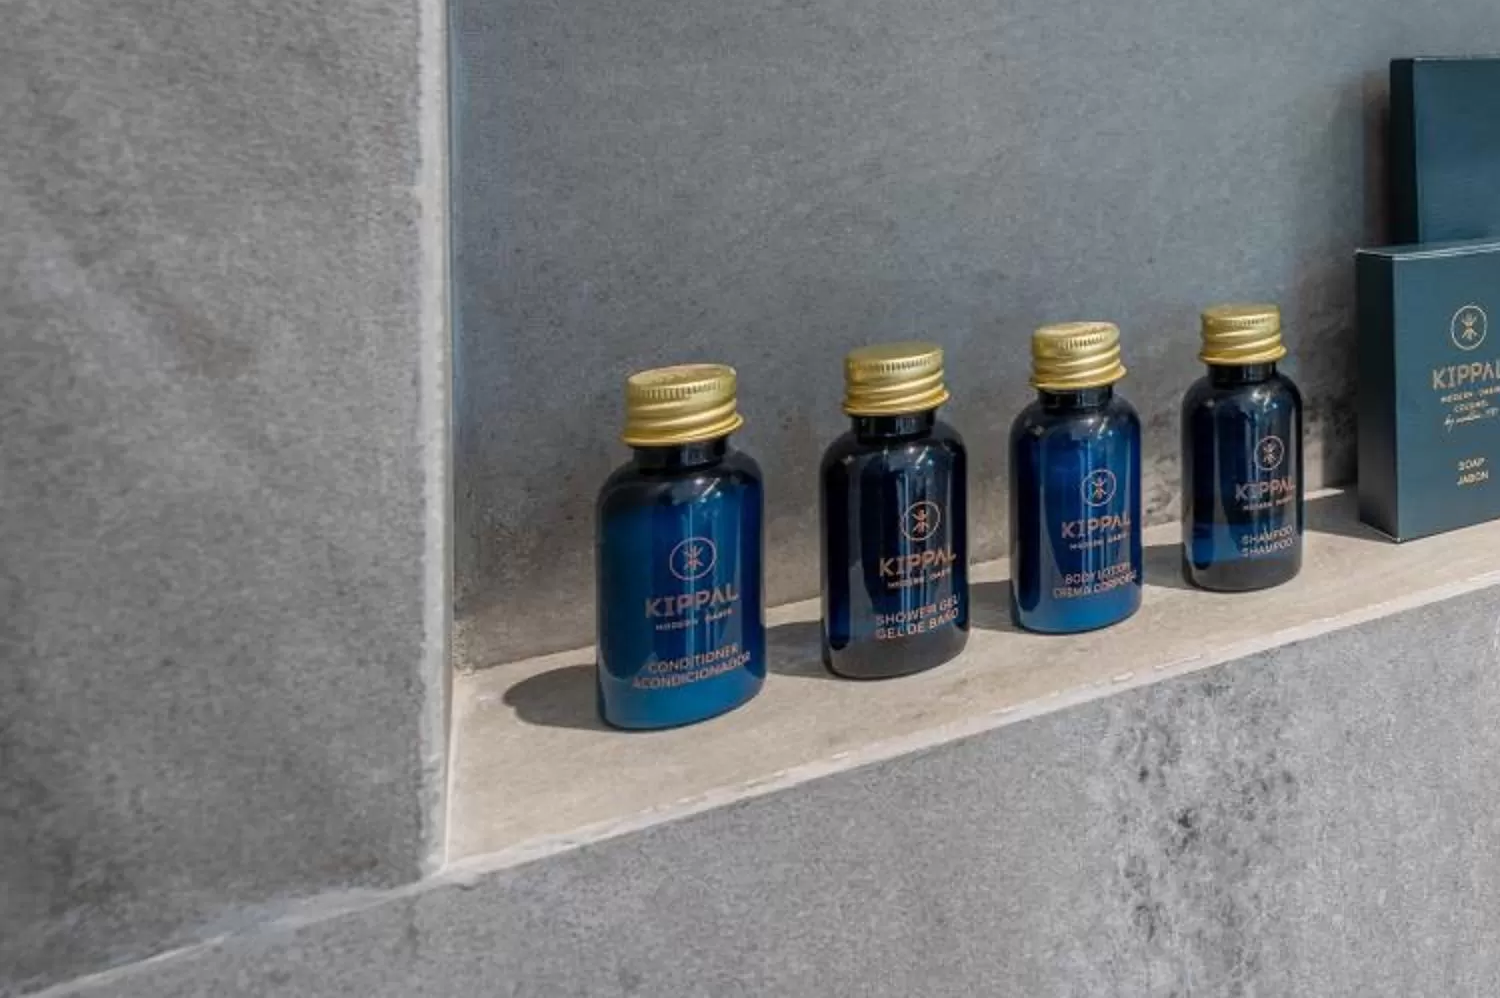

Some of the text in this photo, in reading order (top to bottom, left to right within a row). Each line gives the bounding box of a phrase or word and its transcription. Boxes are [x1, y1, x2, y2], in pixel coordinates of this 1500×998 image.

[1235, 476, 1297, 501] KIPPAL
[1062, 512, 1131, 539] KIPPAL
[880, 545, 957, 578] KIPPAL
[644, 582, 741, 620] KIPPAL
[907, 620, 926, 636] DE
